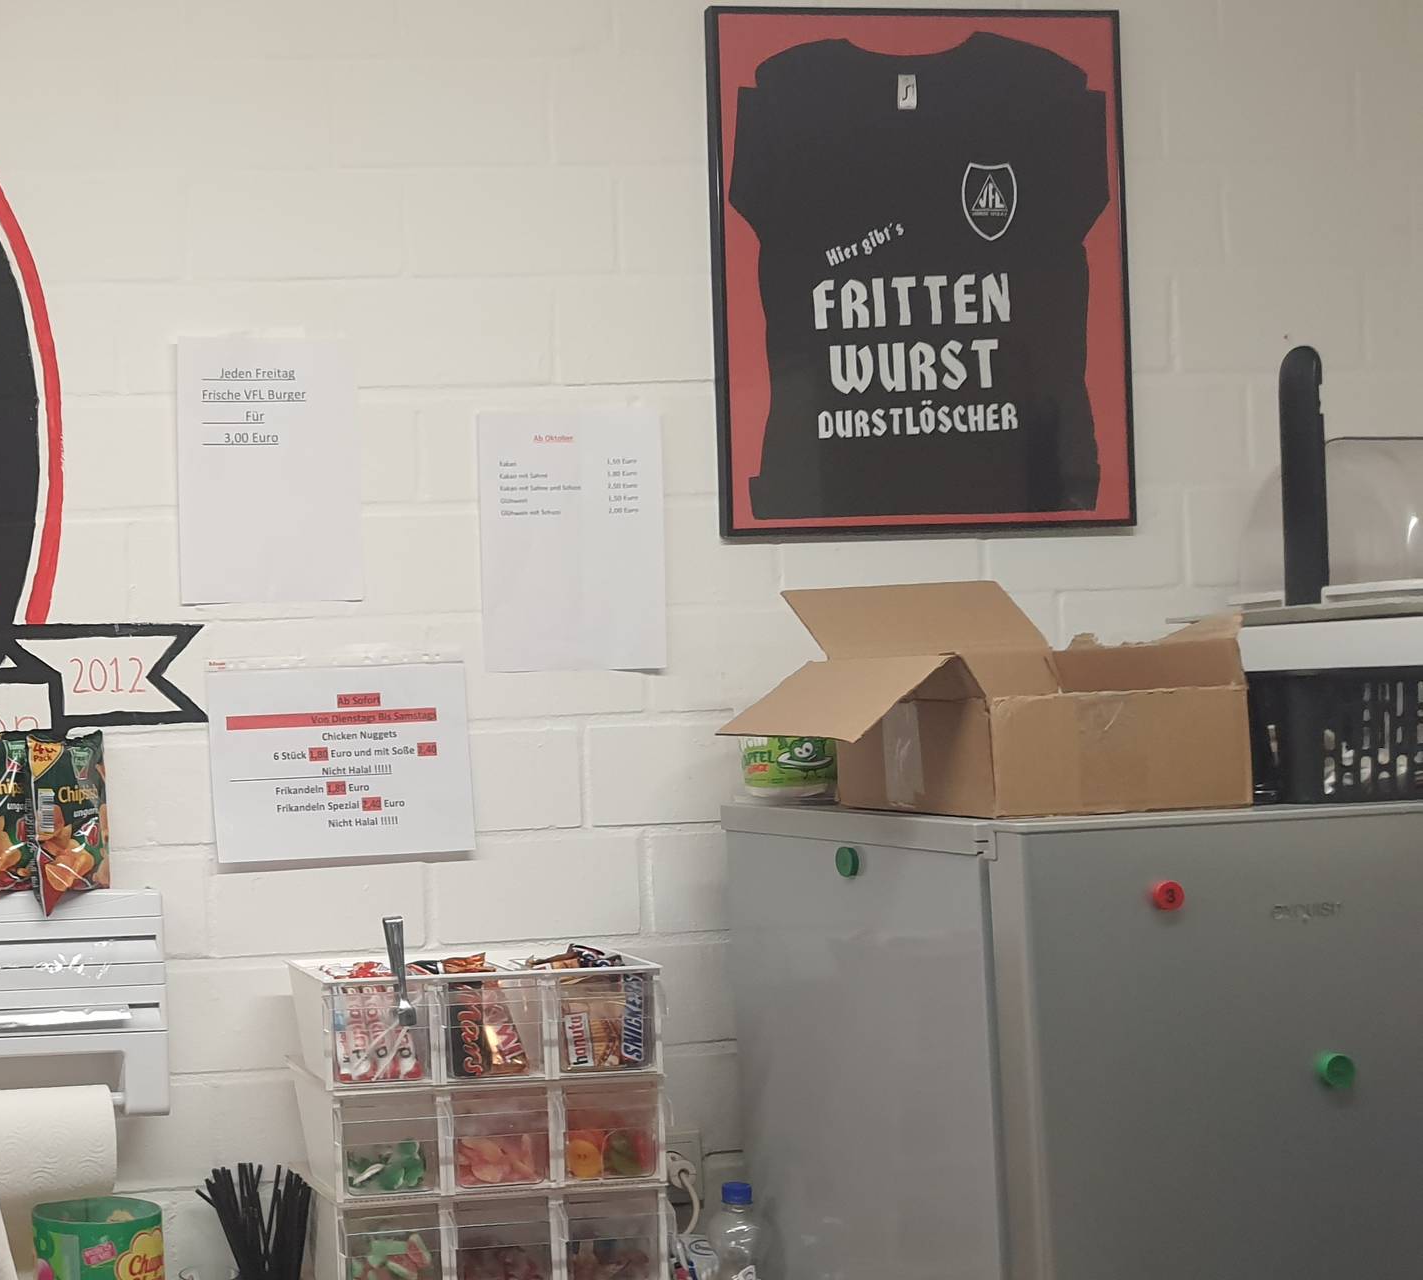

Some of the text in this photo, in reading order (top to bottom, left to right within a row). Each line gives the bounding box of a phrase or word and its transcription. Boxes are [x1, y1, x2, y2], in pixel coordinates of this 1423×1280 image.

[826, 243, 858, 266] Hier
[812, 273, 1011, 330] FRITTEN
[829, 339, 999, 395] WURST
[220, 368, 296, 380] Jeden Freitag
[201, 389, 306, 401] Frische VFL Burger
[245, 411, 265, 422] Für
[818, 400, 1019, 439] DURSTLÖSCHER
[224, 433, 279, 444] 3,00 Euro
[69, 657, 145, 693] 2012
[337, 697, 350, 705] Ab
[311, 716, 328, 724] Von
[331, 714, 376, 724] Dienstags
[378, 713, 392, 721] Bis
[321, 730, 397, 741] Chicken Nuggets
[273, 752, 279, 760] 6
[281, 751, 307, 760] Stück
[309, 749, 329, 760] 1,80
[331, 750, 352, 758] Euro
[354, 748, 372, 757] und
[374, 747, 390, 756] mit
[392, 746, 415, 755] Soße
[321, 767, 346, 776] Nicht
[348, 766, 372, 774] Halal
[275, 783, 370, 795] Frikandeln 1,80 Euro
[276, 803, 326, 813] Frikandeln
[328, 801, 360, 811] Spezial
[384, 799, 405, 808] Euro
[328, 818, 353, 828] Nicht
[355, 817, 378, 826] Halal
[1166, 889, 1176, 903] 3
[568, 1016, 588, 1065] hanuta
